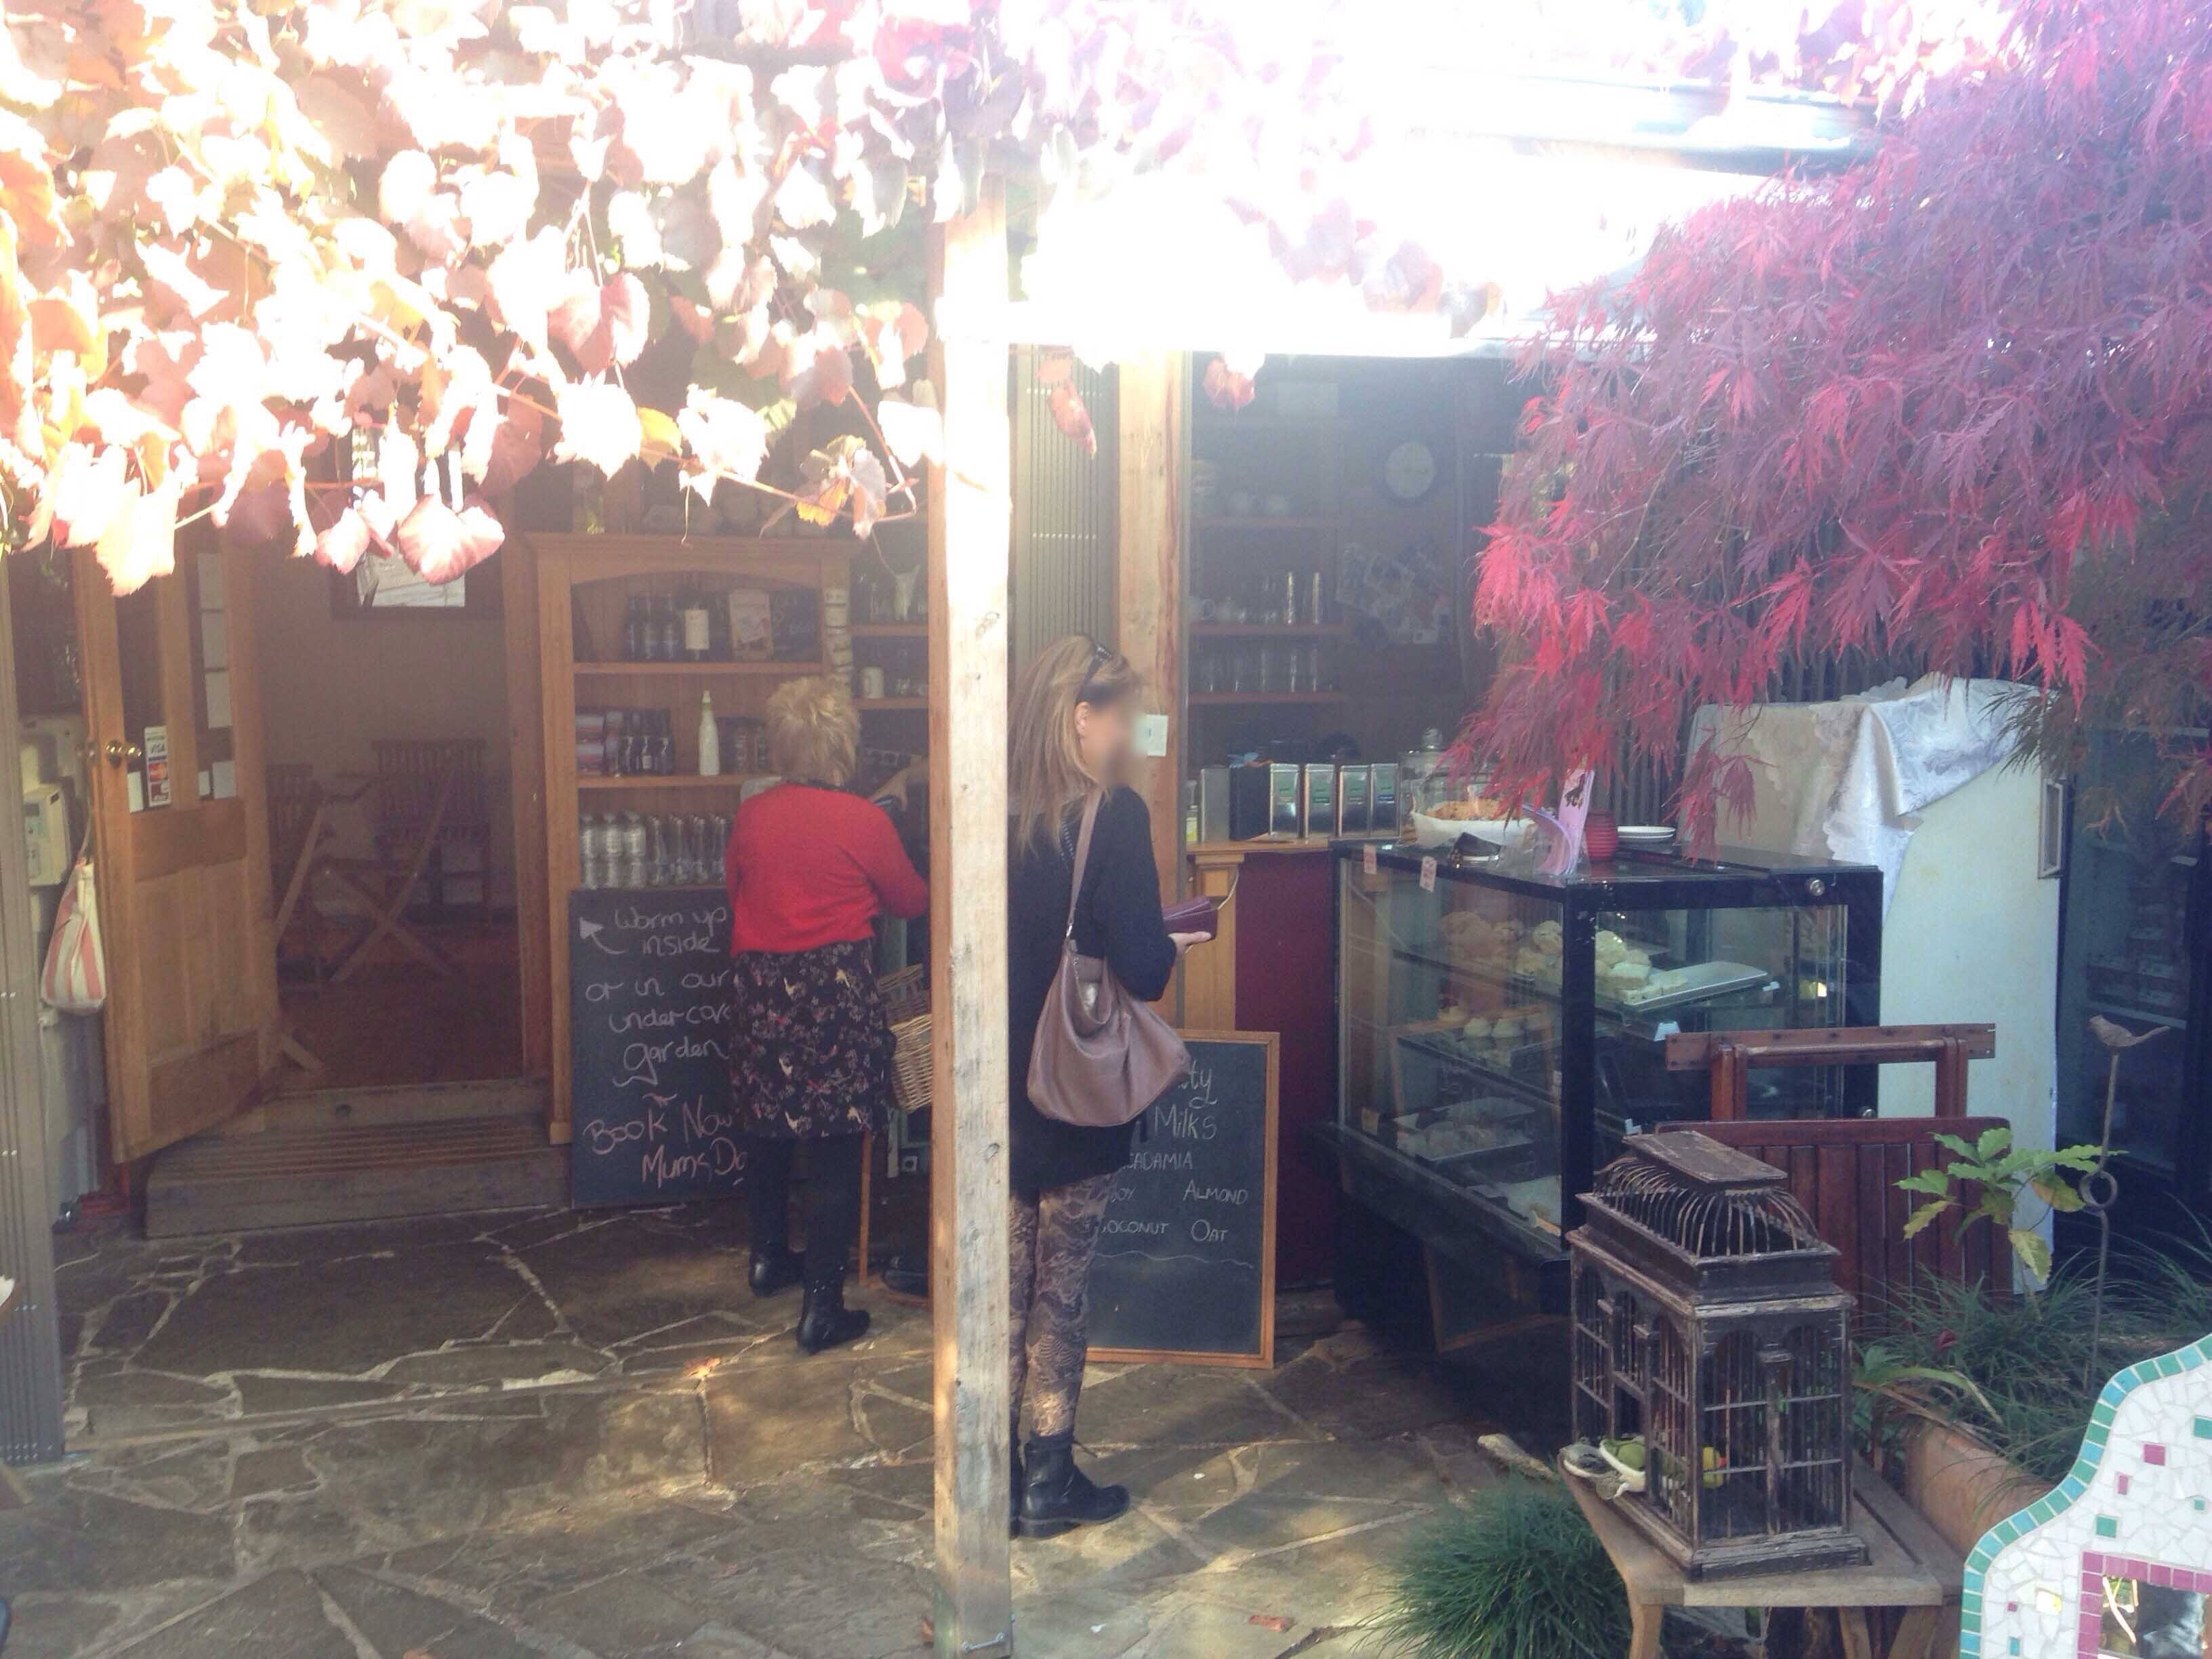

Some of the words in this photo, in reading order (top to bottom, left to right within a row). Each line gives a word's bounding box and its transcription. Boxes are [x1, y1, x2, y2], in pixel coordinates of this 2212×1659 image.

[692, 906, 727, 937] up
[642, 932, 721, 957] inside
[585, 982, 624, 1002] or
[634, 977, 665, 997] in
[681, 969, 730, 988] our
[1102, 1221, 1169, 1235] OCONUT
